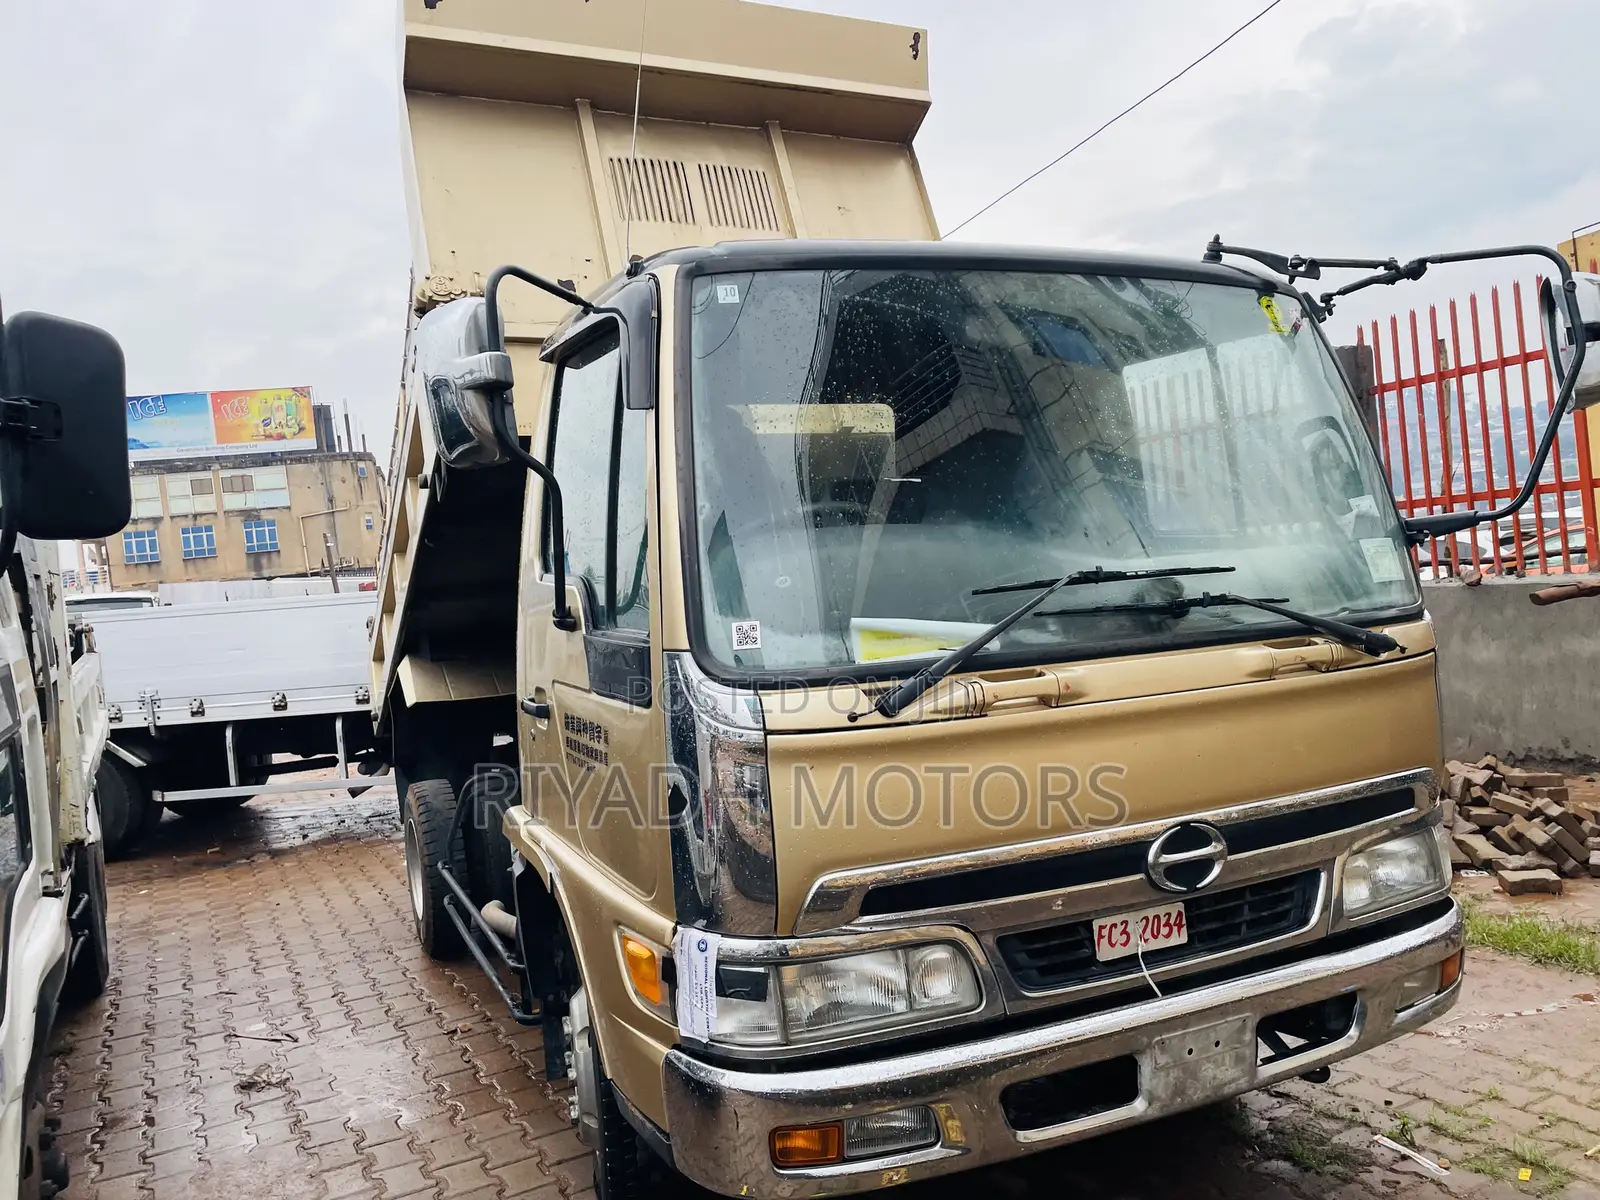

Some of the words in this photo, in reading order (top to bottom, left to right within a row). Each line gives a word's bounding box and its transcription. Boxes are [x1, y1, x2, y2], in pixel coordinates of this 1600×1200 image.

[724, 287, 736, 297] 10
[127, 395, 167, 421] ICE
[221, 397, 249, 423] ICE
[1097, 920, 1131, 952] FC3
[1139, 909, 1186, 944] 2034
